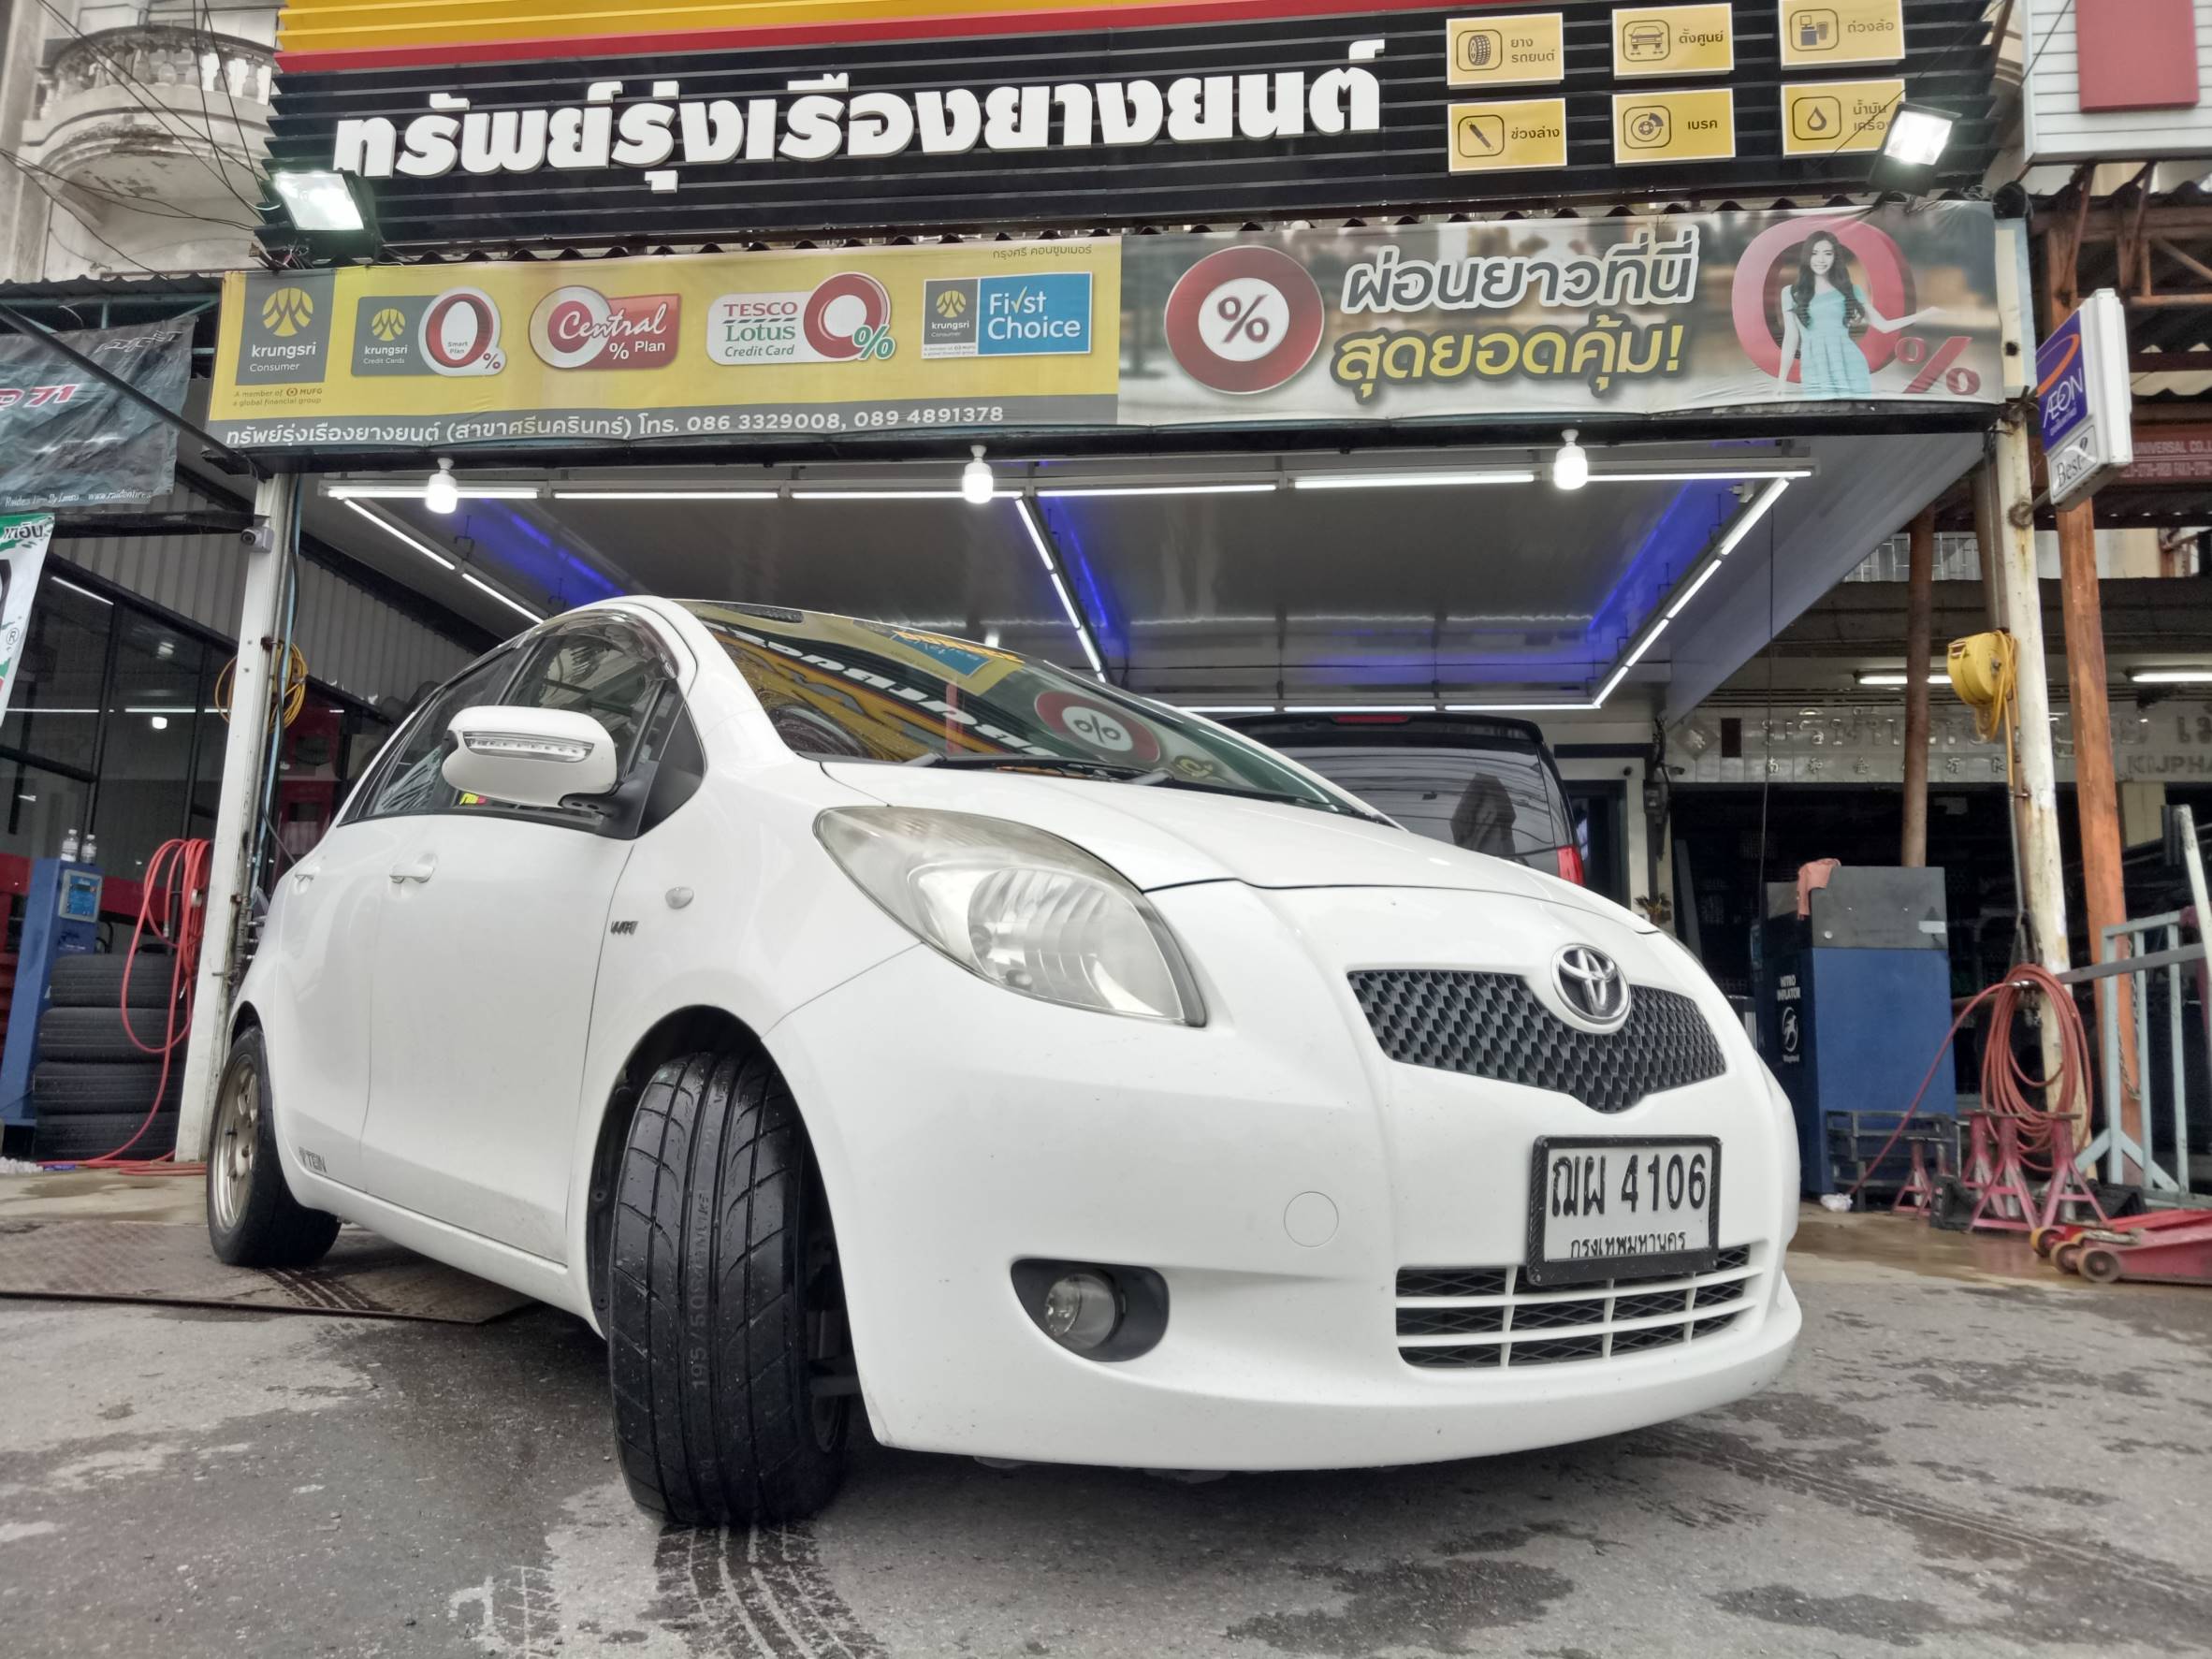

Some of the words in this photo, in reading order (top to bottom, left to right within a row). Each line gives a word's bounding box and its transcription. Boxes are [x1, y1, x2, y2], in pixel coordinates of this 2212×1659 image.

[1510, 37, 1534, 48] ยาง
[1679, 28, 1724, 47] ตั้งศูนย์
[1511, 49, 1555, 64] รถยนต์
[333, 38, 1385, 194] ทรัพย์รุ่งเรืองยางยนต์
[1511, 124, 1561, 140] ช่วงล่าง
[1687, 119, 1718, 131] เบรค
[993, 246, 1027, 261] กรุงศรี
[1344, 226, 1696, 312] ผ่อนยาวที่นี่
[723, 301, 798, 317] TESCO
[559, 302, 667, 341] Central
[931, 320, 970, 330] krungsri
[987, 315, 1082, 340] Choice
[725, 323, 796, 342] Lotus
[251, 341, 317, 359] krungsri
[364, 344, 408, 356] krungsri
[634, 341, 665, 353] Plan
[725, 344, 764, 357] Credit
[765, 344, 795, 357] Card
[1336, 314, 1684, 399] สุดยอดคุ้ม!
[249, 362, 300, 372] Consumer
[241, 389, 273, 398] member
[299, 387, 323, 396] MUFG
[264, 397, 298, 408] financial
[226, 421, 442, 447] ทรัพย์รุ่งเรืองยางยนต์
[638, 412, 679, 435] โทร.
[687, 415, 731, 432] 086
[737, 412, 847, 432] 3329008,
[853, 410, 899, 428] 089
[906, 406, 1004, 425] 4891378
[1621, 1153, 1707, 1213] 4106
[1571, 1230, 1686, 1259] กรงเทพมหานคร
